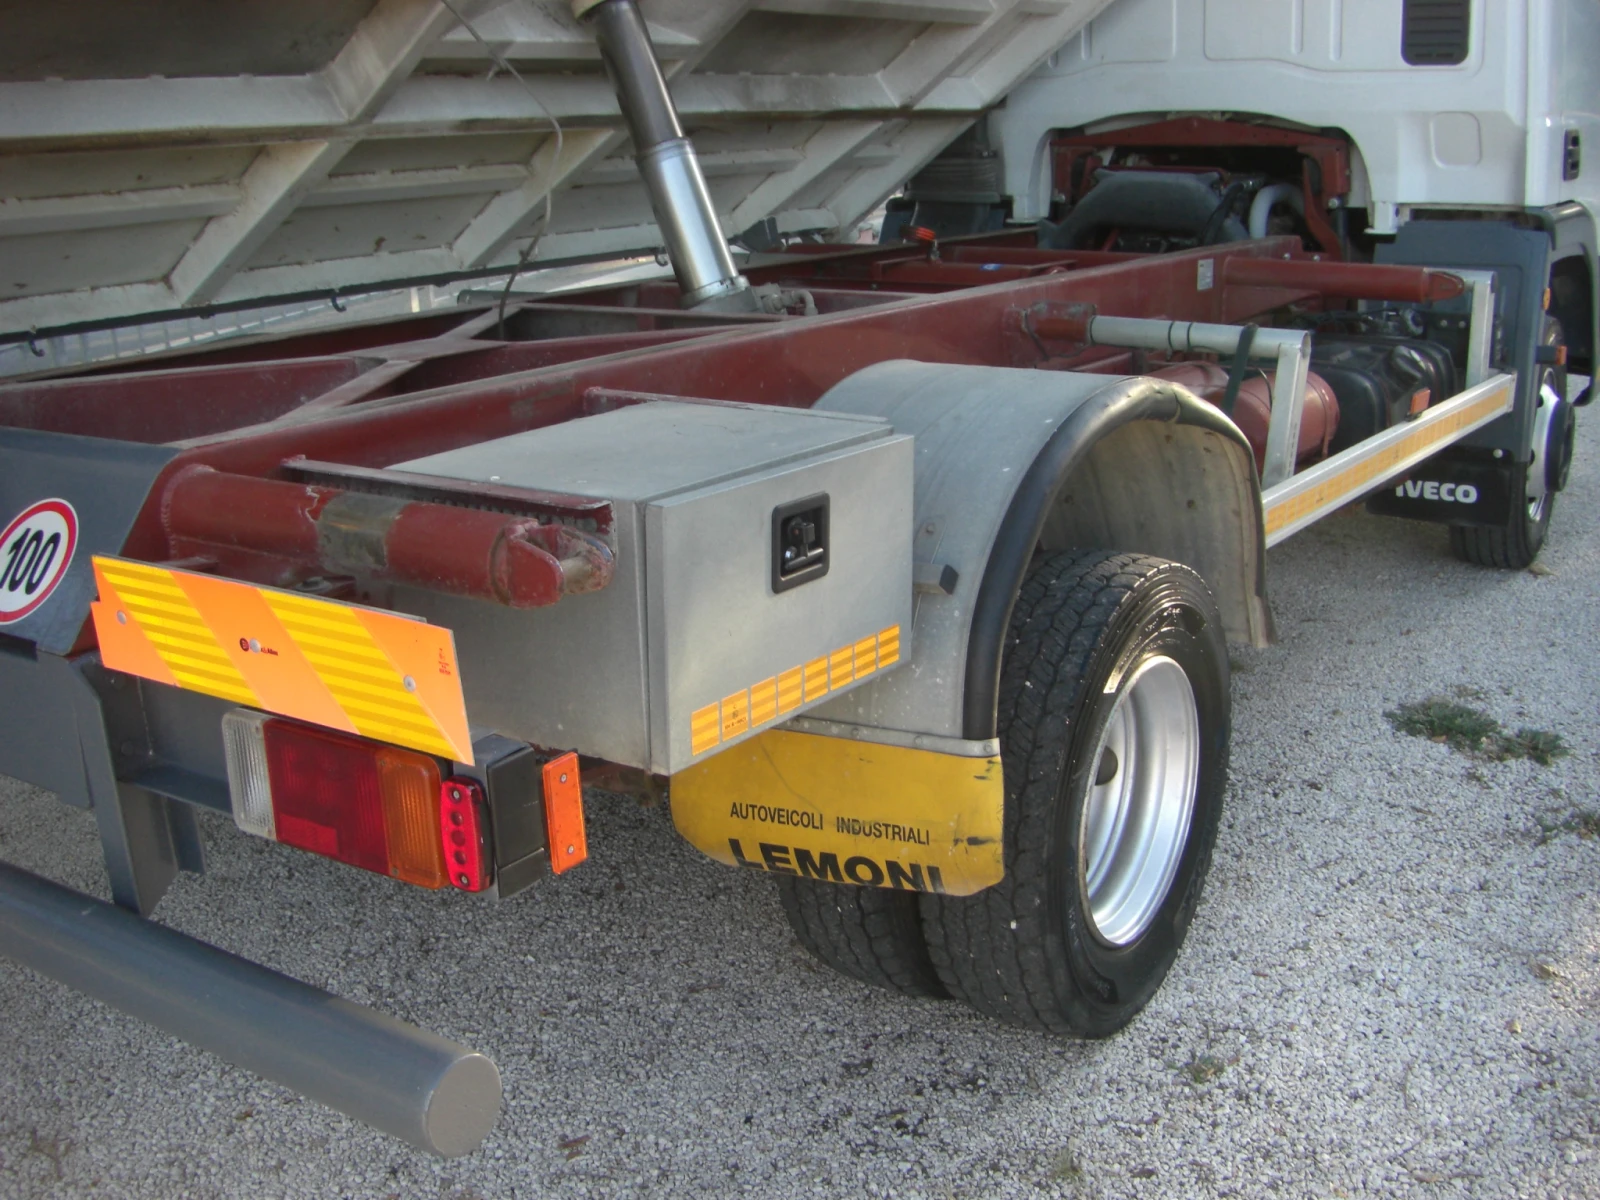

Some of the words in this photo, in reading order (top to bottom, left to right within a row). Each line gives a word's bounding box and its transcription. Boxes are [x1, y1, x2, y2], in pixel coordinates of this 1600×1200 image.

[1396, 480, 1478, 504] IVECO
[0, 528, 61, 595] 100
[730, 802, 824, 831] AUTOVEICOLI
[836, 816, 930, 846] INDUSTRIALI
[728, 838, 946, 894] LEMONI
